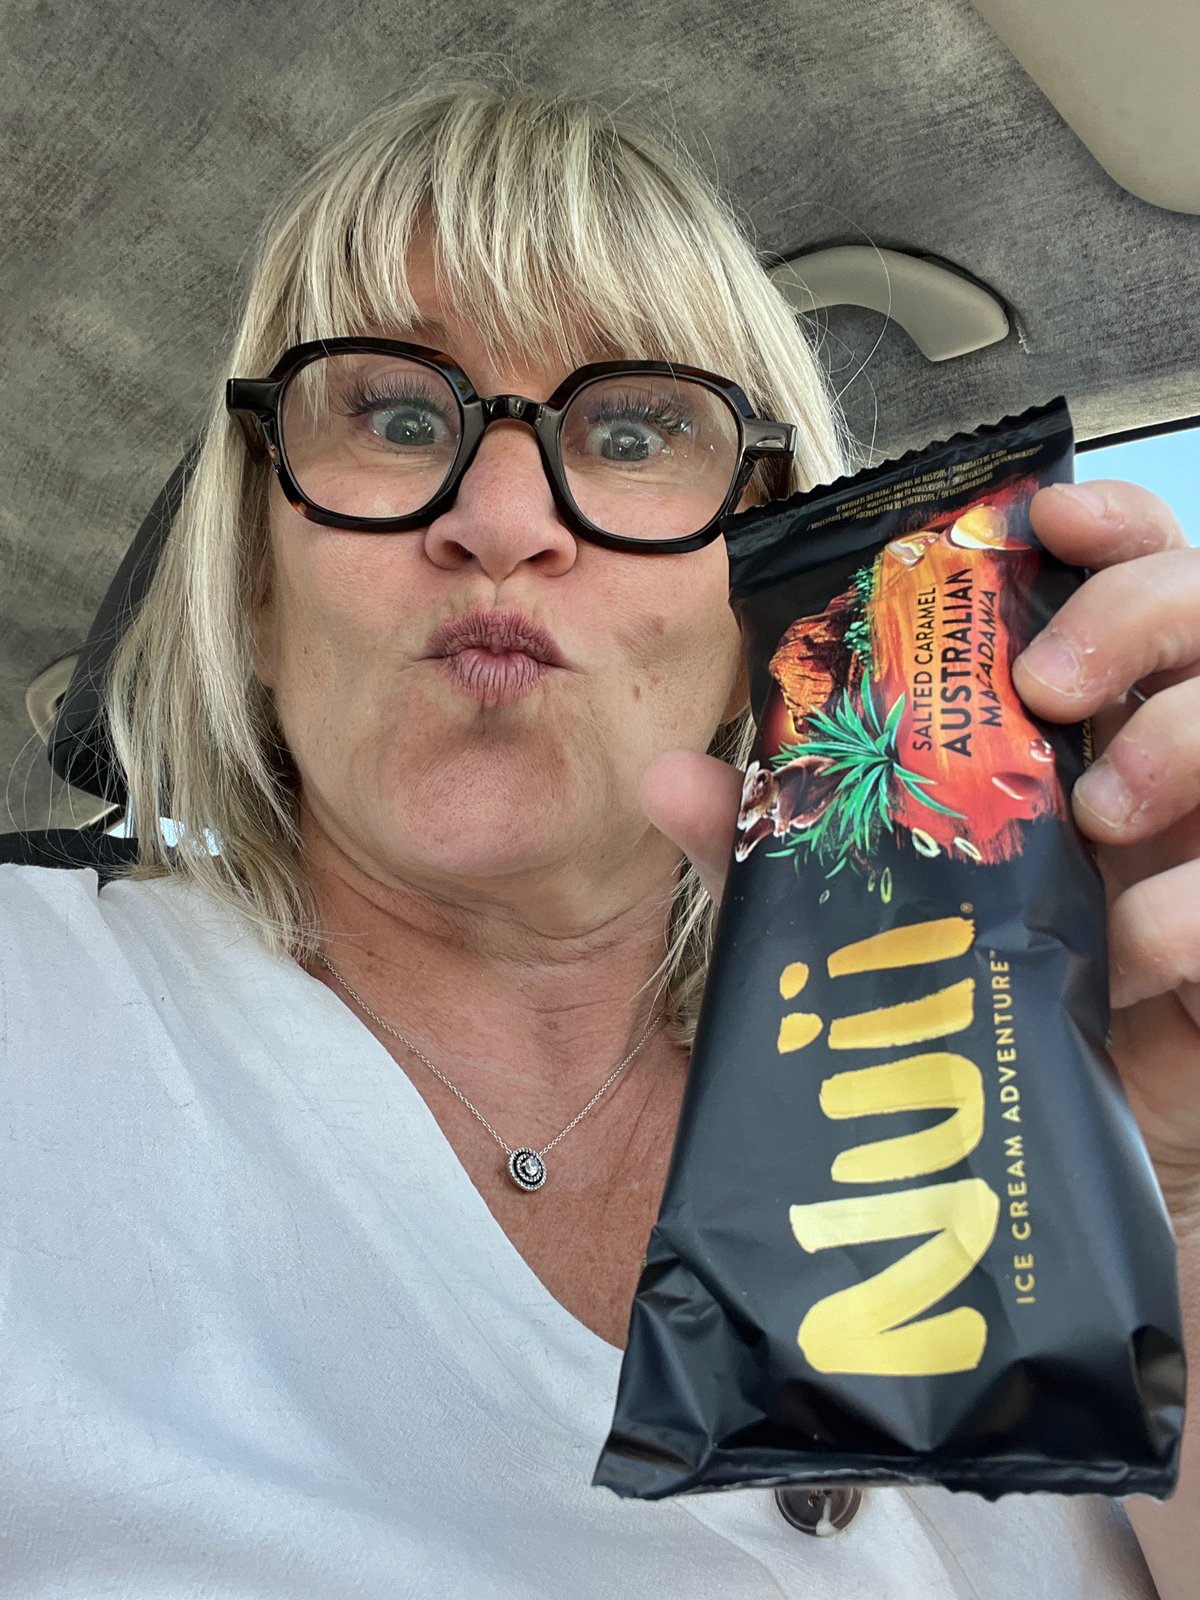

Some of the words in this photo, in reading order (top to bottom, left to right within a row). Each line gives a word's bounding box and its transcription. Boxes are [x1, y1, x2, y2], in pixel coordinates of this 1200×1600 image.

[914, 587, 937, 665] CARAMEL
[940, 568, 974, 758] AUSTRALIAN
[976, 590, 1003, 727] MACADAMIA
[913, 671, 933, 751] SALTED
[990, 960, 1021, 1123] ADVENTURE
[1003, 1136, 1032, 1239] CREAM
[1015, 1253, 1036, 1304] ICE
